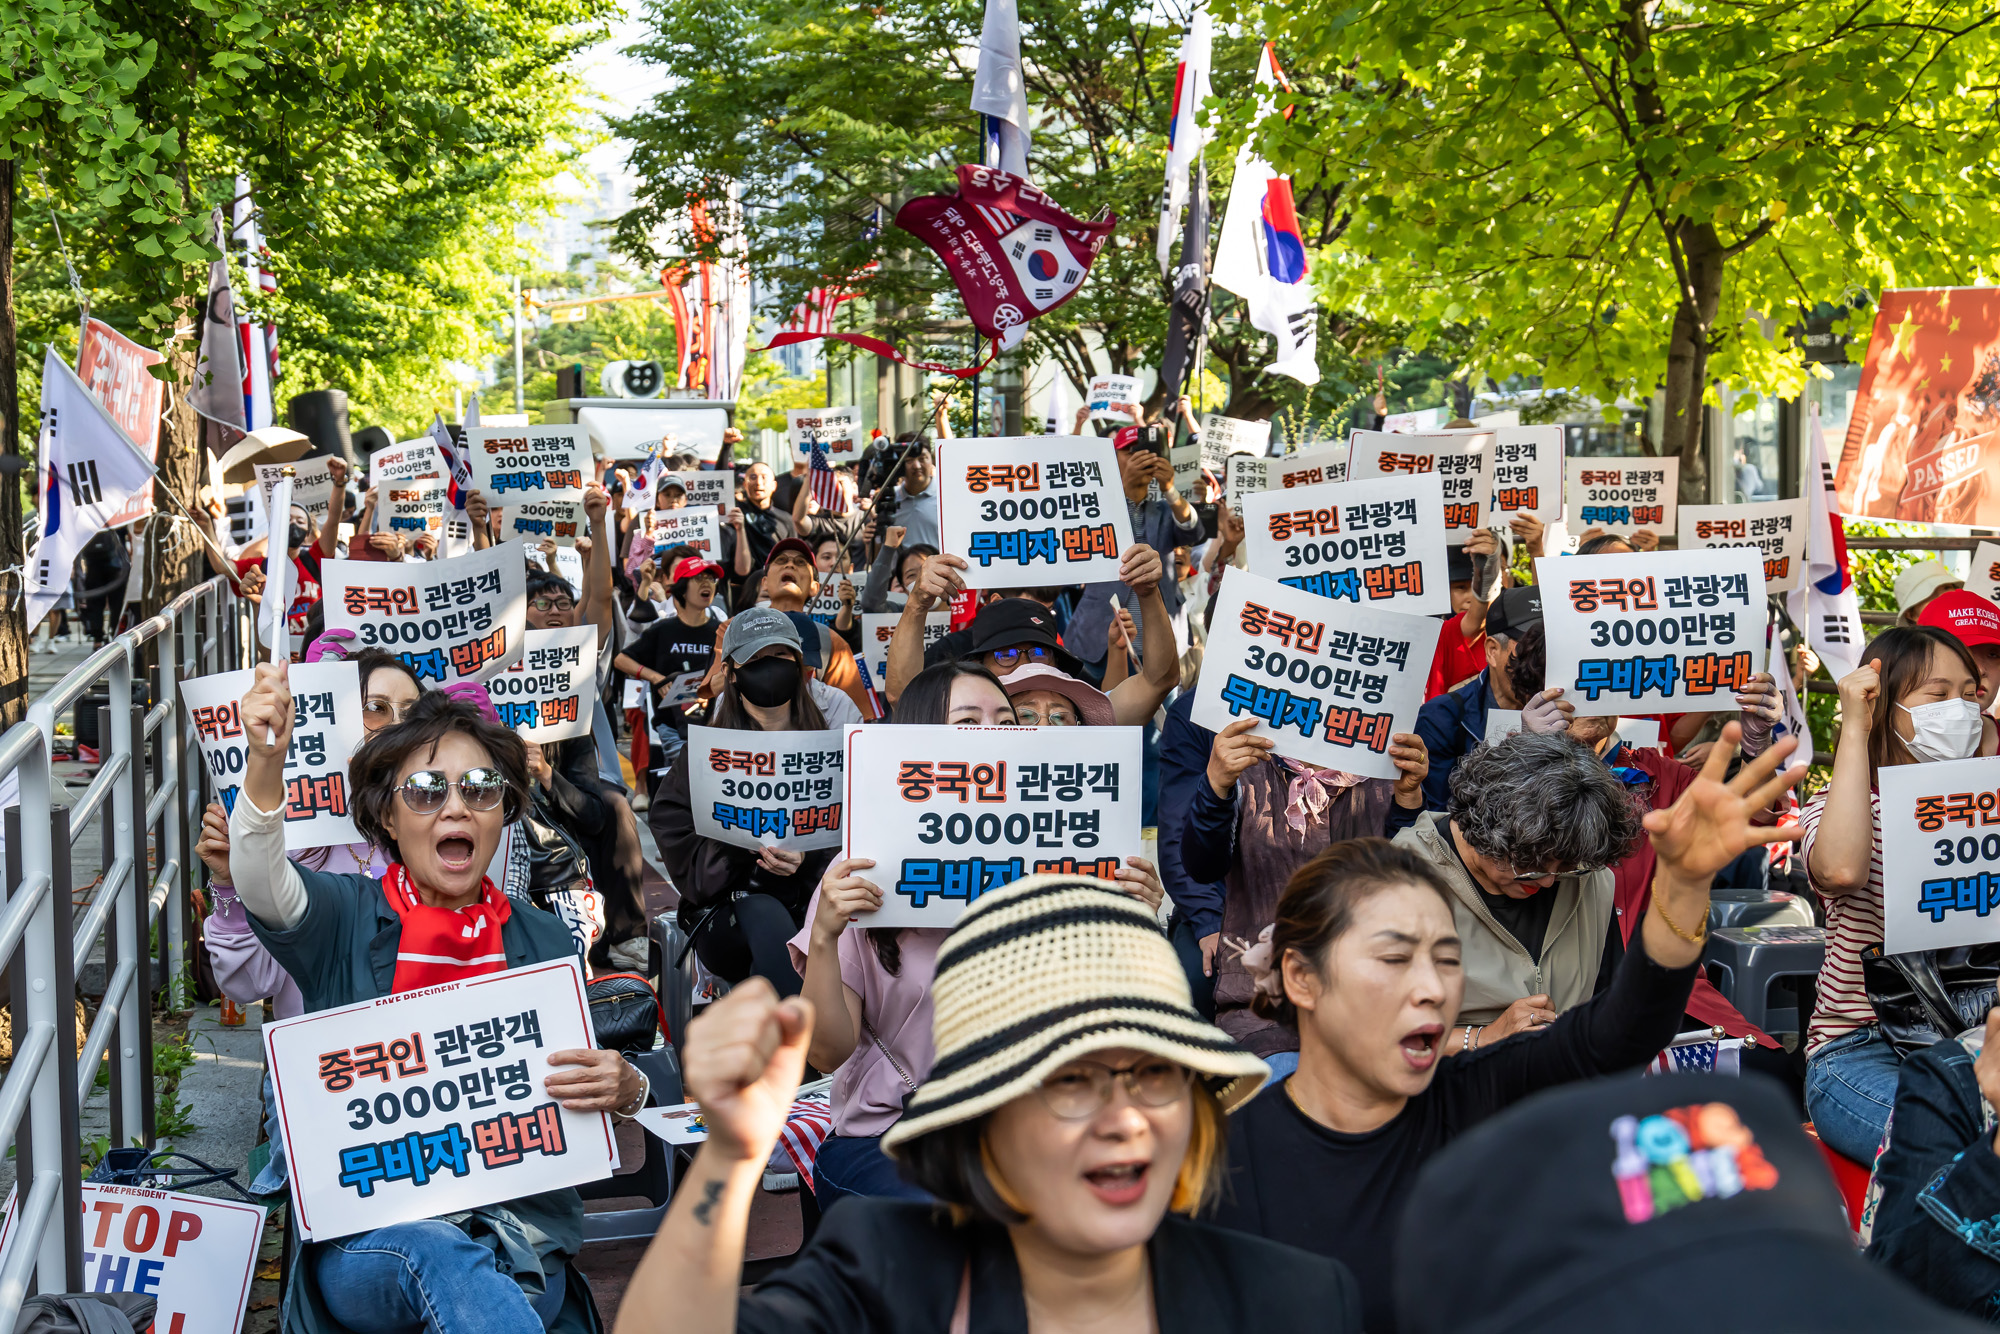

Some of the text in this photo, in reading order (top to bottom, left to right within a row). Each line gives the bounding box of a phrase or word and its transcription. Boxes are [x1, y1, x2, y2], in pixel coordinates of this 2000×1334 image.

[825, 415, 851, 426] 관광객
[378, 446, 435, 468] 중국인 관광객
[483, 436, 575, 455] 중국인 관광객
[831, 439, 853, 453] 반대
[383, 460, 431, 476] 3000만명
[495, 453, 570, 469] 3000만명
[1235, 461, 1268, 474] 중국인
[1378, 451, 1434, 474] 중국인
[1438, 454, 1482, 474] 관광객
[1912, 443, 1980, 492] PASSED
[490, 470, 582, 493] 무비자 반대
[697, 480, 724, 490] 관광객
[966, 461, 1103, 493] 중국인 관광객
[1235, 476, 1268, 489] 관광객
[1282, 467, 1323, 489] 중국인
[1580, 470, 1664, 485] 중국인 관광객
[389, 490, 420, 502] 중국인
[395, 502, 443, 513] 3000만명
[981, 492, 1100, 521] 3000만명
[1498, 487, 1538, 511] 반대
[1588, 488, 1657, 502] 3000만명
[389, 517, 427, 531] 무비자
[520, 504, 574, 519] 3000만명
[1268, 498, 1417, 542] 중국인 관광객
[1581, 505, 1664, 525] 무비자 반대
[514, 518, 577, 537] 무비자 반대
[1696, 516, 1792, 539] 중국인 관광객
[968, 523, 1118, 567] 무비자 반대
[1284, 531, 1407, 567] 3000만명
[344, 569, 501, 616] 중국인 관광객
[1363, 560, 1423, 600] 반대
[1569, 573, 1750, 613] 중국인 관광객
[360, 603, 492, 645] 3000만명
[1948, 608, 2000, 622] MAKE KOREA
[1955, 619, 1998, 630] GREAT AGAIN
[1240, 600, 1410, 672] 중국인 관광객
[1590, 612, 1736, 647] 3000만명
[450, 626, 506, 677] 반대
[529, 645, 580, 670] 관광객
[670, 643, 712, 654] ATELIE
[1244, 645, 1388, 705] 3000만명
[1575, 650, 1752, 701] 무비자 반대
[192, 700, 243, 743] 중국인
[541, 695, 579, 726] 반대
[1221, 673, 1393, 753] 무비자 반대
[709, 748, 776, 776] 중국인
[721, 777, 833, 802] 3000만명
[897, 760, 1120, 803] 중국인 관광객
[284, 771, 347, 822] 반대
[712, 801, 842, 839] 무비자 반대
[1914, 788, 2000, 832] 중국인
[917, 809, 1100, 848] 3000만명
[318, 1009, 544, 1093] 중국인 관광객
[346, 1059, 533, 1131] 3000만명
[338, 1101, 567, 1198] 무비자 반대
[99, 1185, 168, 1200] FAKE PRESIDENT
[82, 1200, 203, 1258] TOP
